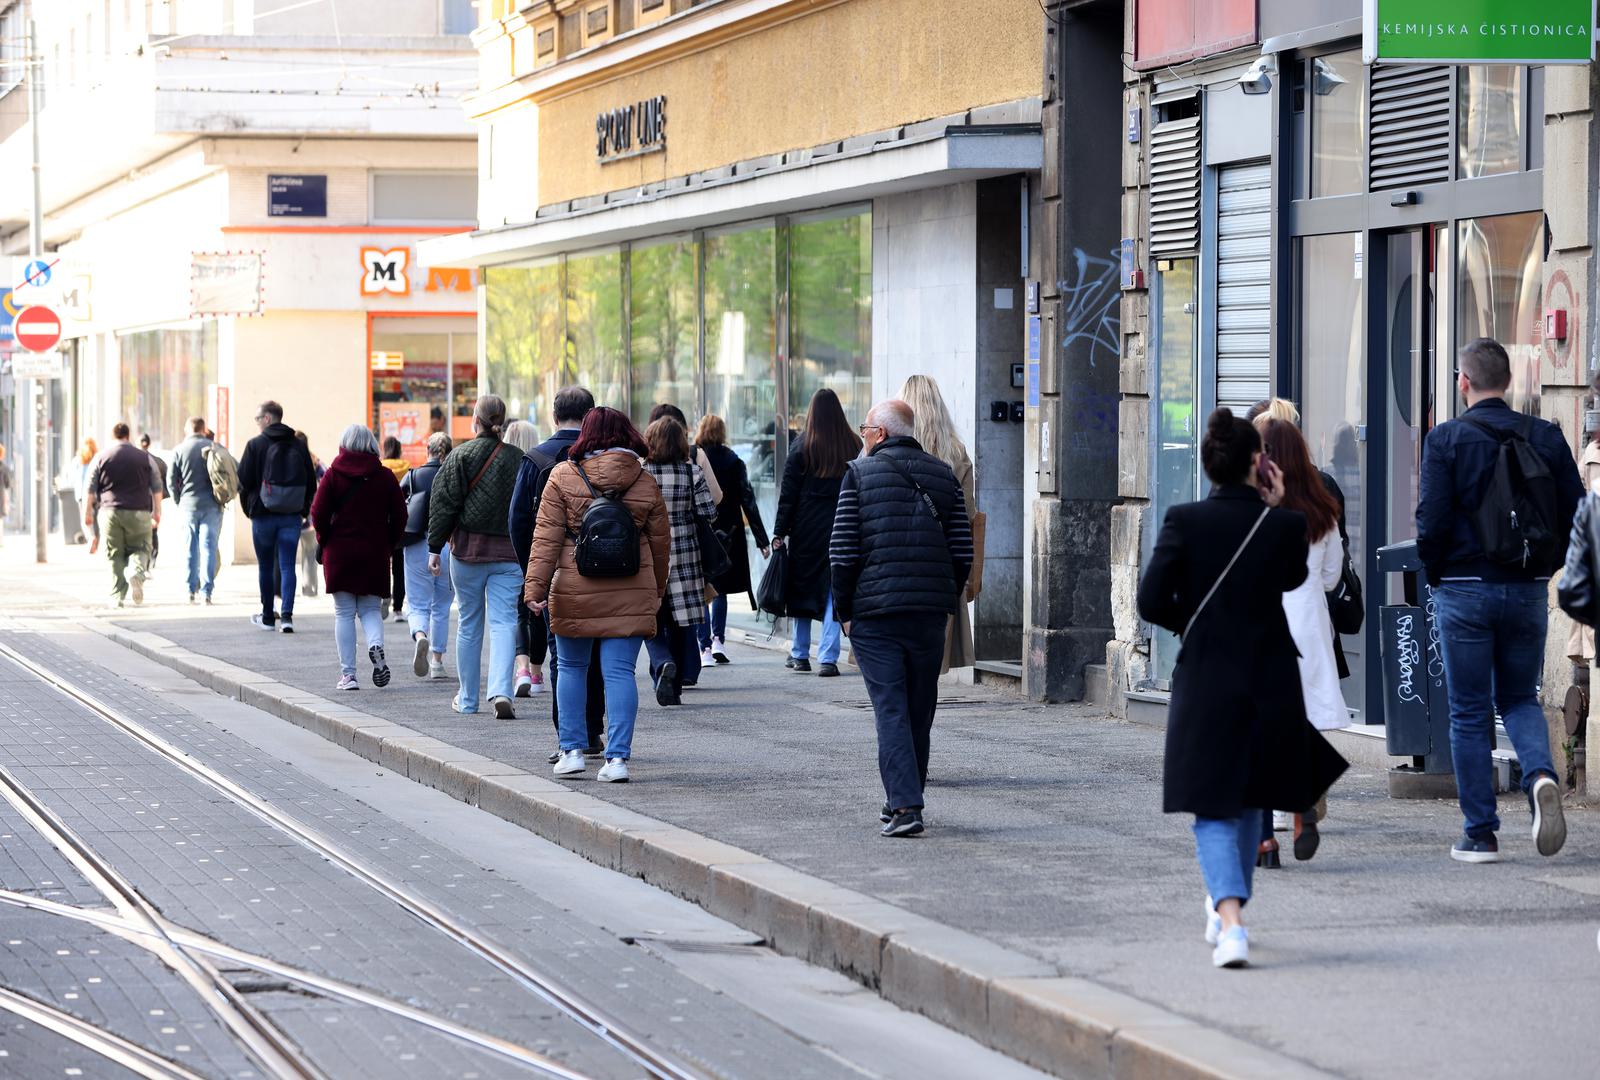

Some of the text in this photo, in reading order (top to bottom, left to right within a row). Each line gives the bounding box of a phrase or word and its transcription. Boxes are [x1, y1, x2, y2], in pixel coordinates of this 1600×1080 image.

[1383, 21, 1587, 37] KEMIJSKA ČISTIONICA
[596, 95, 667, 157] SPORT LINE
[372, 261, 396, 281] M
